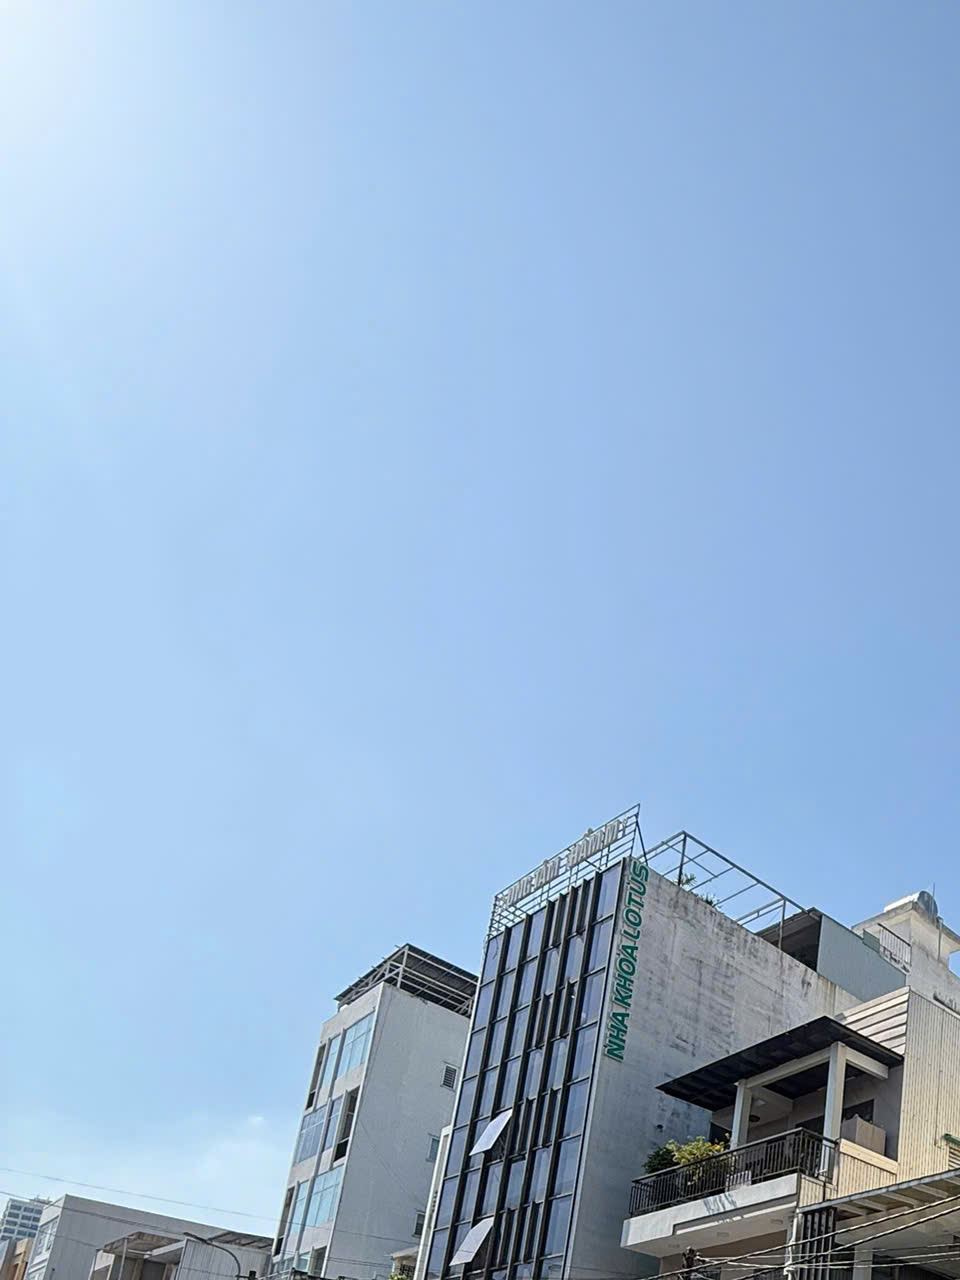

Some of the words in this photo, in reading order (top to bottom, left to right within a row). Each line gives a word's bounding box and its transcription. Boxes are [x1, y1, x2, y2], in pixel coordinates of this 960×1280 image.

[623, 860, 650, 941] LOTUS
[613, 943, 640, 1008] KHOA
[603, 1011, 630, 1062] NHA
